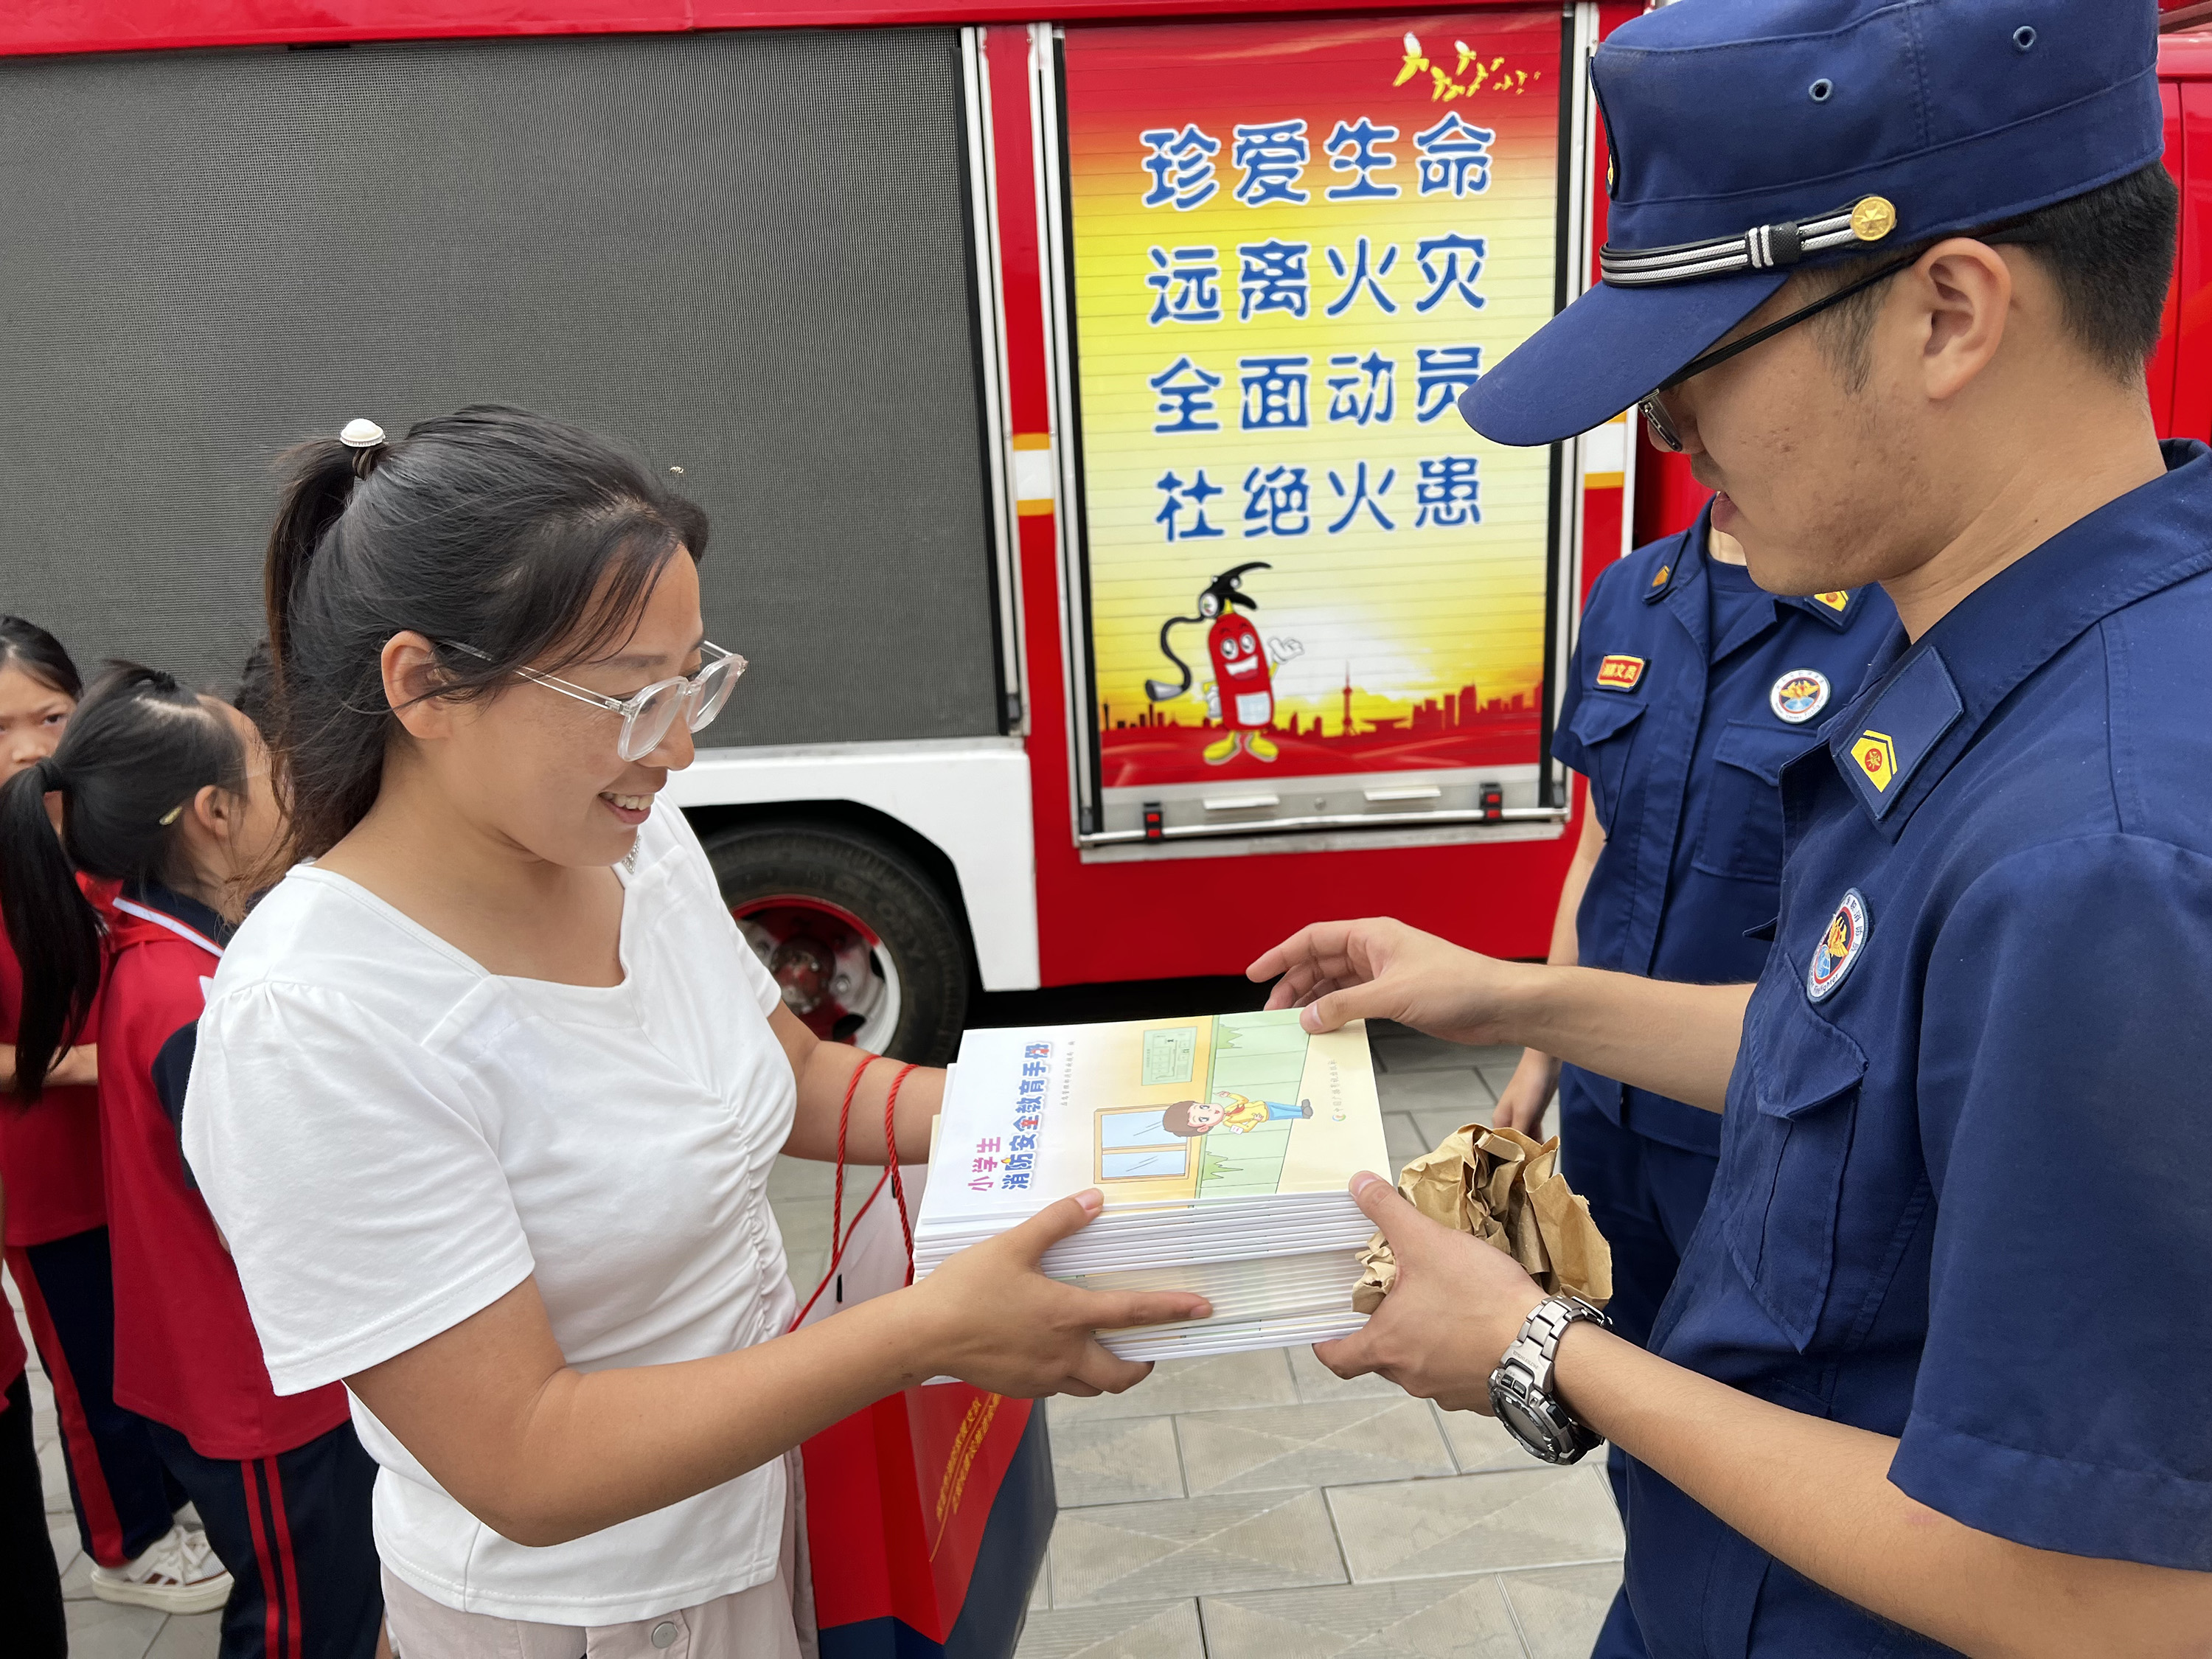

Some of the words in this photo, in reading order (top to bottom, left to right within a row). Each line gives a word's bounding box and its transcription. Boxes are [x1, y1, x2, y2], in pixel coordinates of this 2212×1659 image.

[1141, 113, 1495, 209] 珍爱生命
[1147, 234, 1486, 323] 远离火灾
[1150, 347, 1483, 434] 全面动员
[1156, 456, 1481, 542] 杜绝火患
[1001, 1043, 1050, 1190] 消防安全教育手册
[967, 1136, 1001, 1192] 小学生
